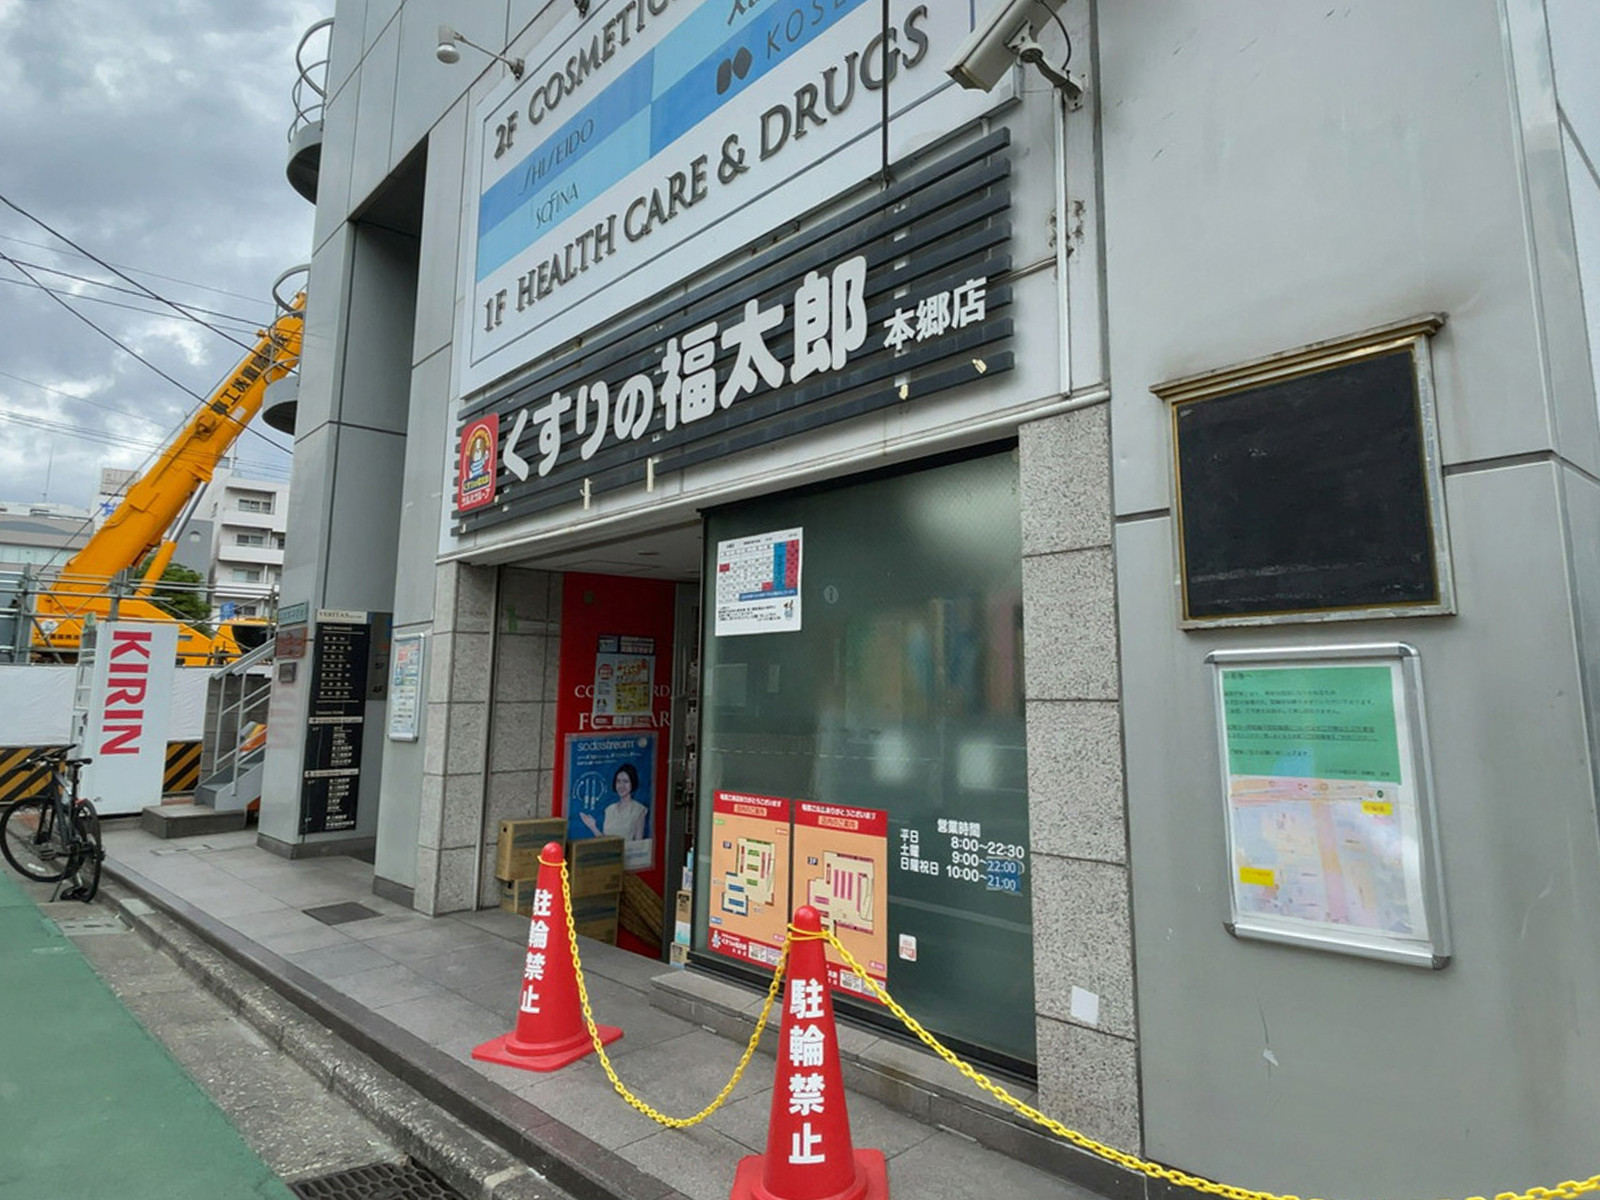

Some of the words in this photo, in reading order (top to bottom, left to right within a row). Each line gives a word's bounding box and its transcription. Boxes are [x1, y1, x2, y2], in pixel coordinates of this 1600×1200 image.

[767, 0, 846, 59] KOS
[493, 110, 518, 159] 2F
[518, 118, 594, 196] SHISEIDO
[484, 288, 507, 332] 1F
[516, 213, 618, 313] HEALTH
[623, 154, 709, 244] CARE
[716, 133, 749, 185] &
[759, 4, 929, 162] DRUGS
[536, 182, 579, 229] SOFINA
[501, 255, 868, 483] くすりの福太郎
[882, 276, 989, 352] 本郷店
[100, 630, 153, 756] KIRIN
[577, 740, 634, 752] sodastream
[900, 828, 919, 843] 平日
[900, 843, 920, 858] 土曜
[937, 818, 981, 839] 営業時間
[900, 857, 939, 876] 日曜祝日
[519, 888, 553, 1015] 駐輪禁止
[788, 978, 826, 1165] 駐輪禁止
